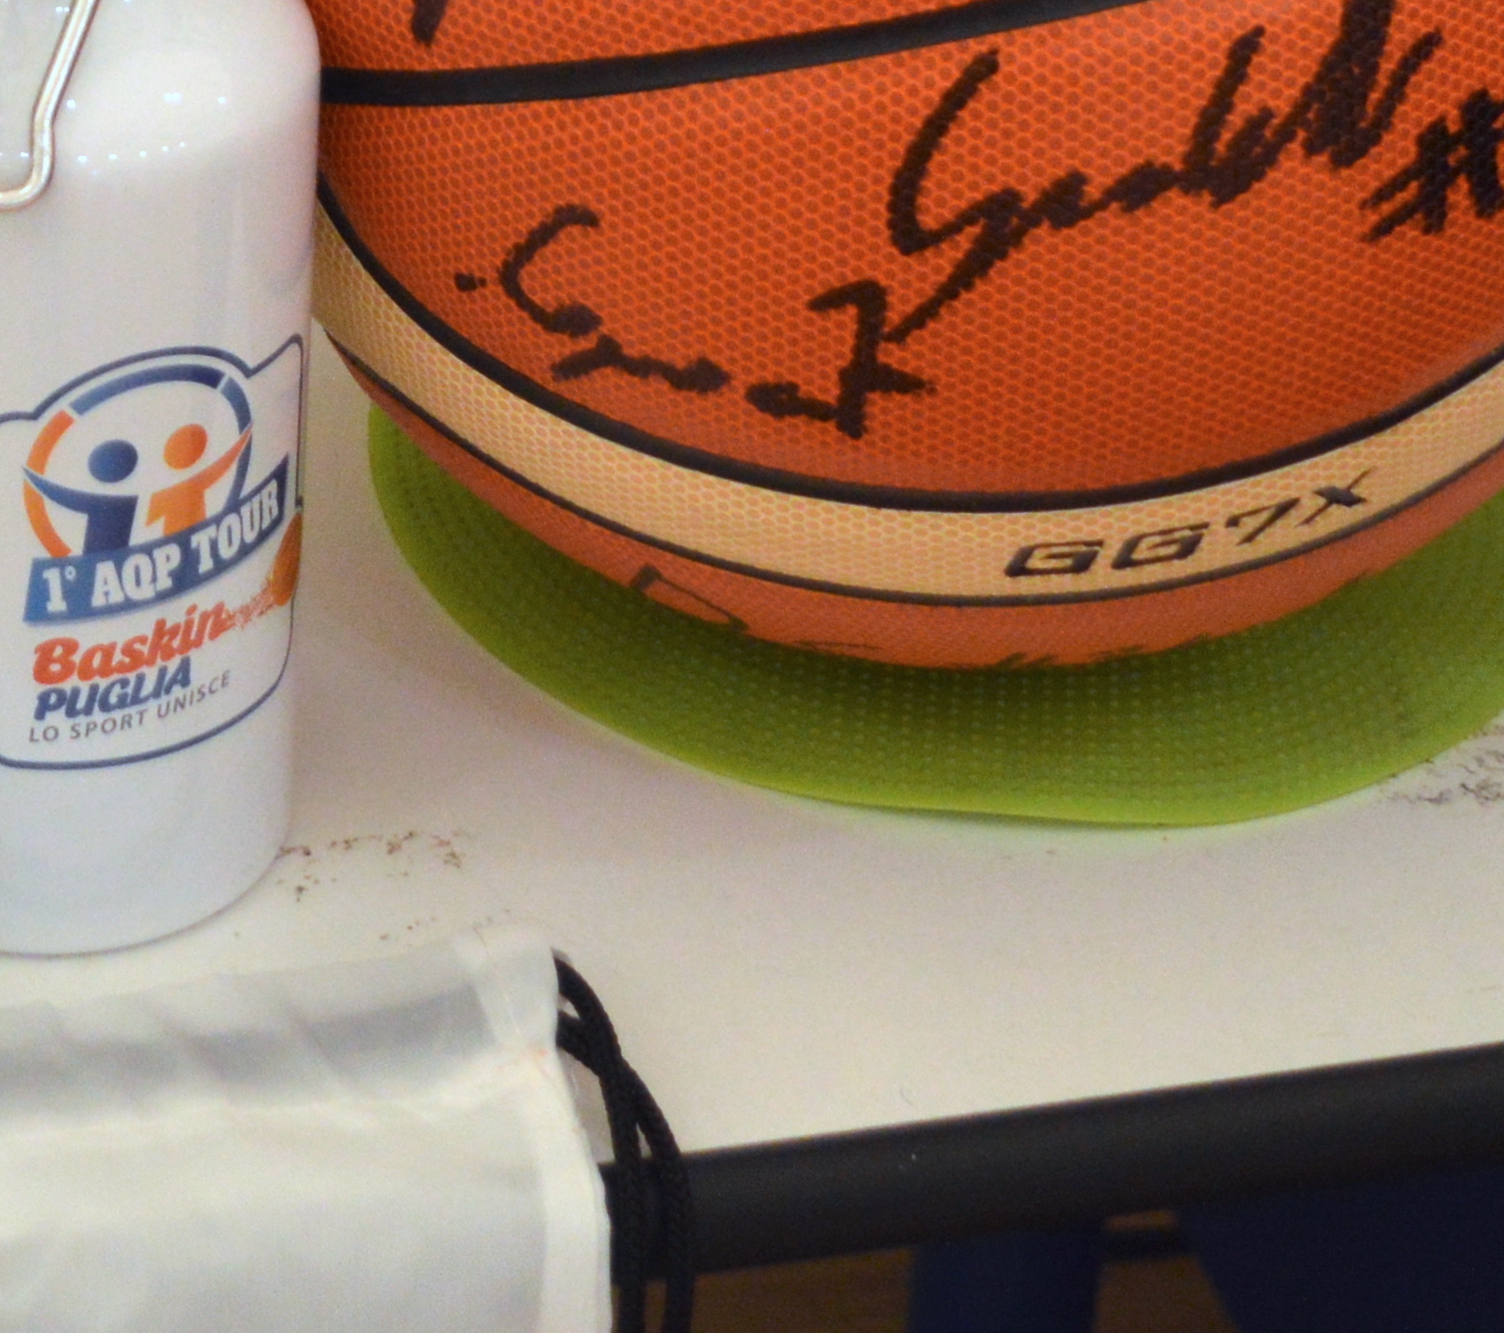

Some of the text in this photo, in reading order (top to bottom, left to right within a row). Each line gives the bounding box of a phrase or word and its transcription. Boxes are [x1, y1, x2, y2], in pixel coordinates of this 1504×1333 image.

[42, 478, 280, 615] 1° AQP TOUR
[1004, 466, 1377, 578] GG7X
[32, 599, 232, 686] Baskin
[28, 669, 232, 744] LO SPORT UNISCE
[33, 655, 193, 722] PUGLIA
